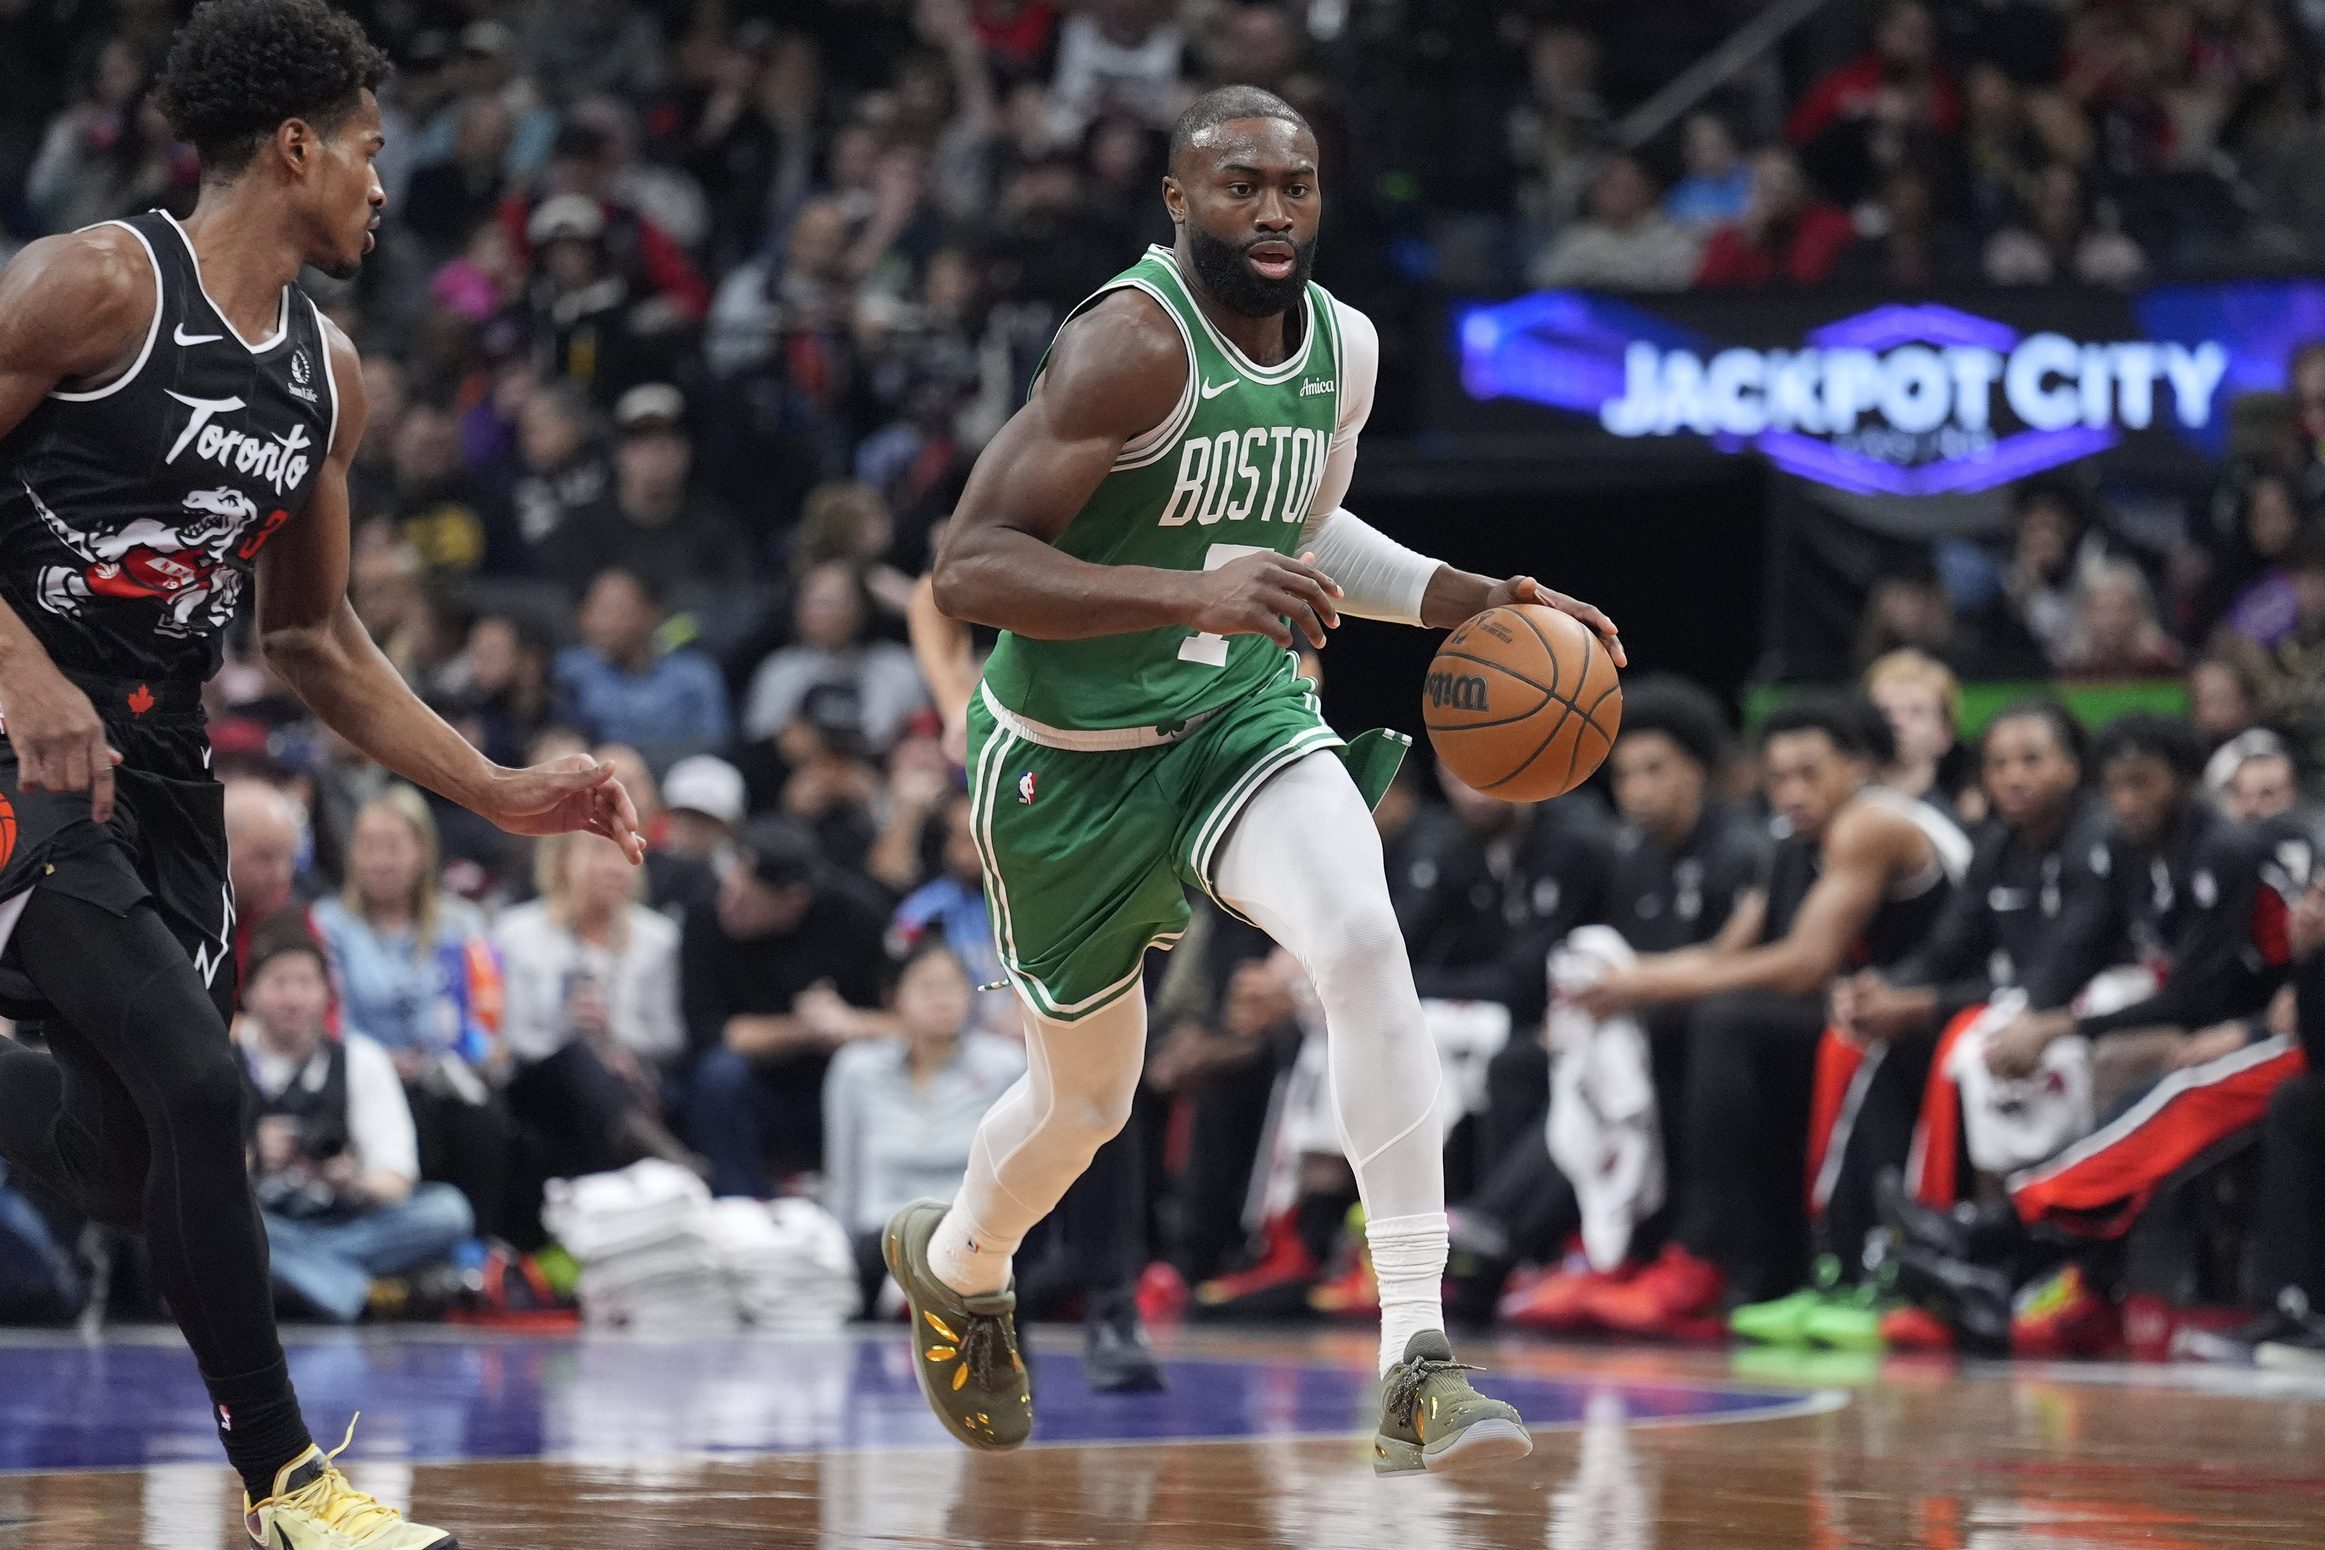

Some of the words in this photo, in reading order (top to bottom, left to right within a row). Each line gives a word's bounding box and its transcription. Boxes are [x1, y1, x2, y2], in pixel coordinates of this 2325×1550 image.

[1300, 376, 1335, 397] Amica
[1601, 340, 2002, 436] JACKPOT
[163, 388, 312, 496] Toronto
[1158, 426, 1333, 527] BOSTON
